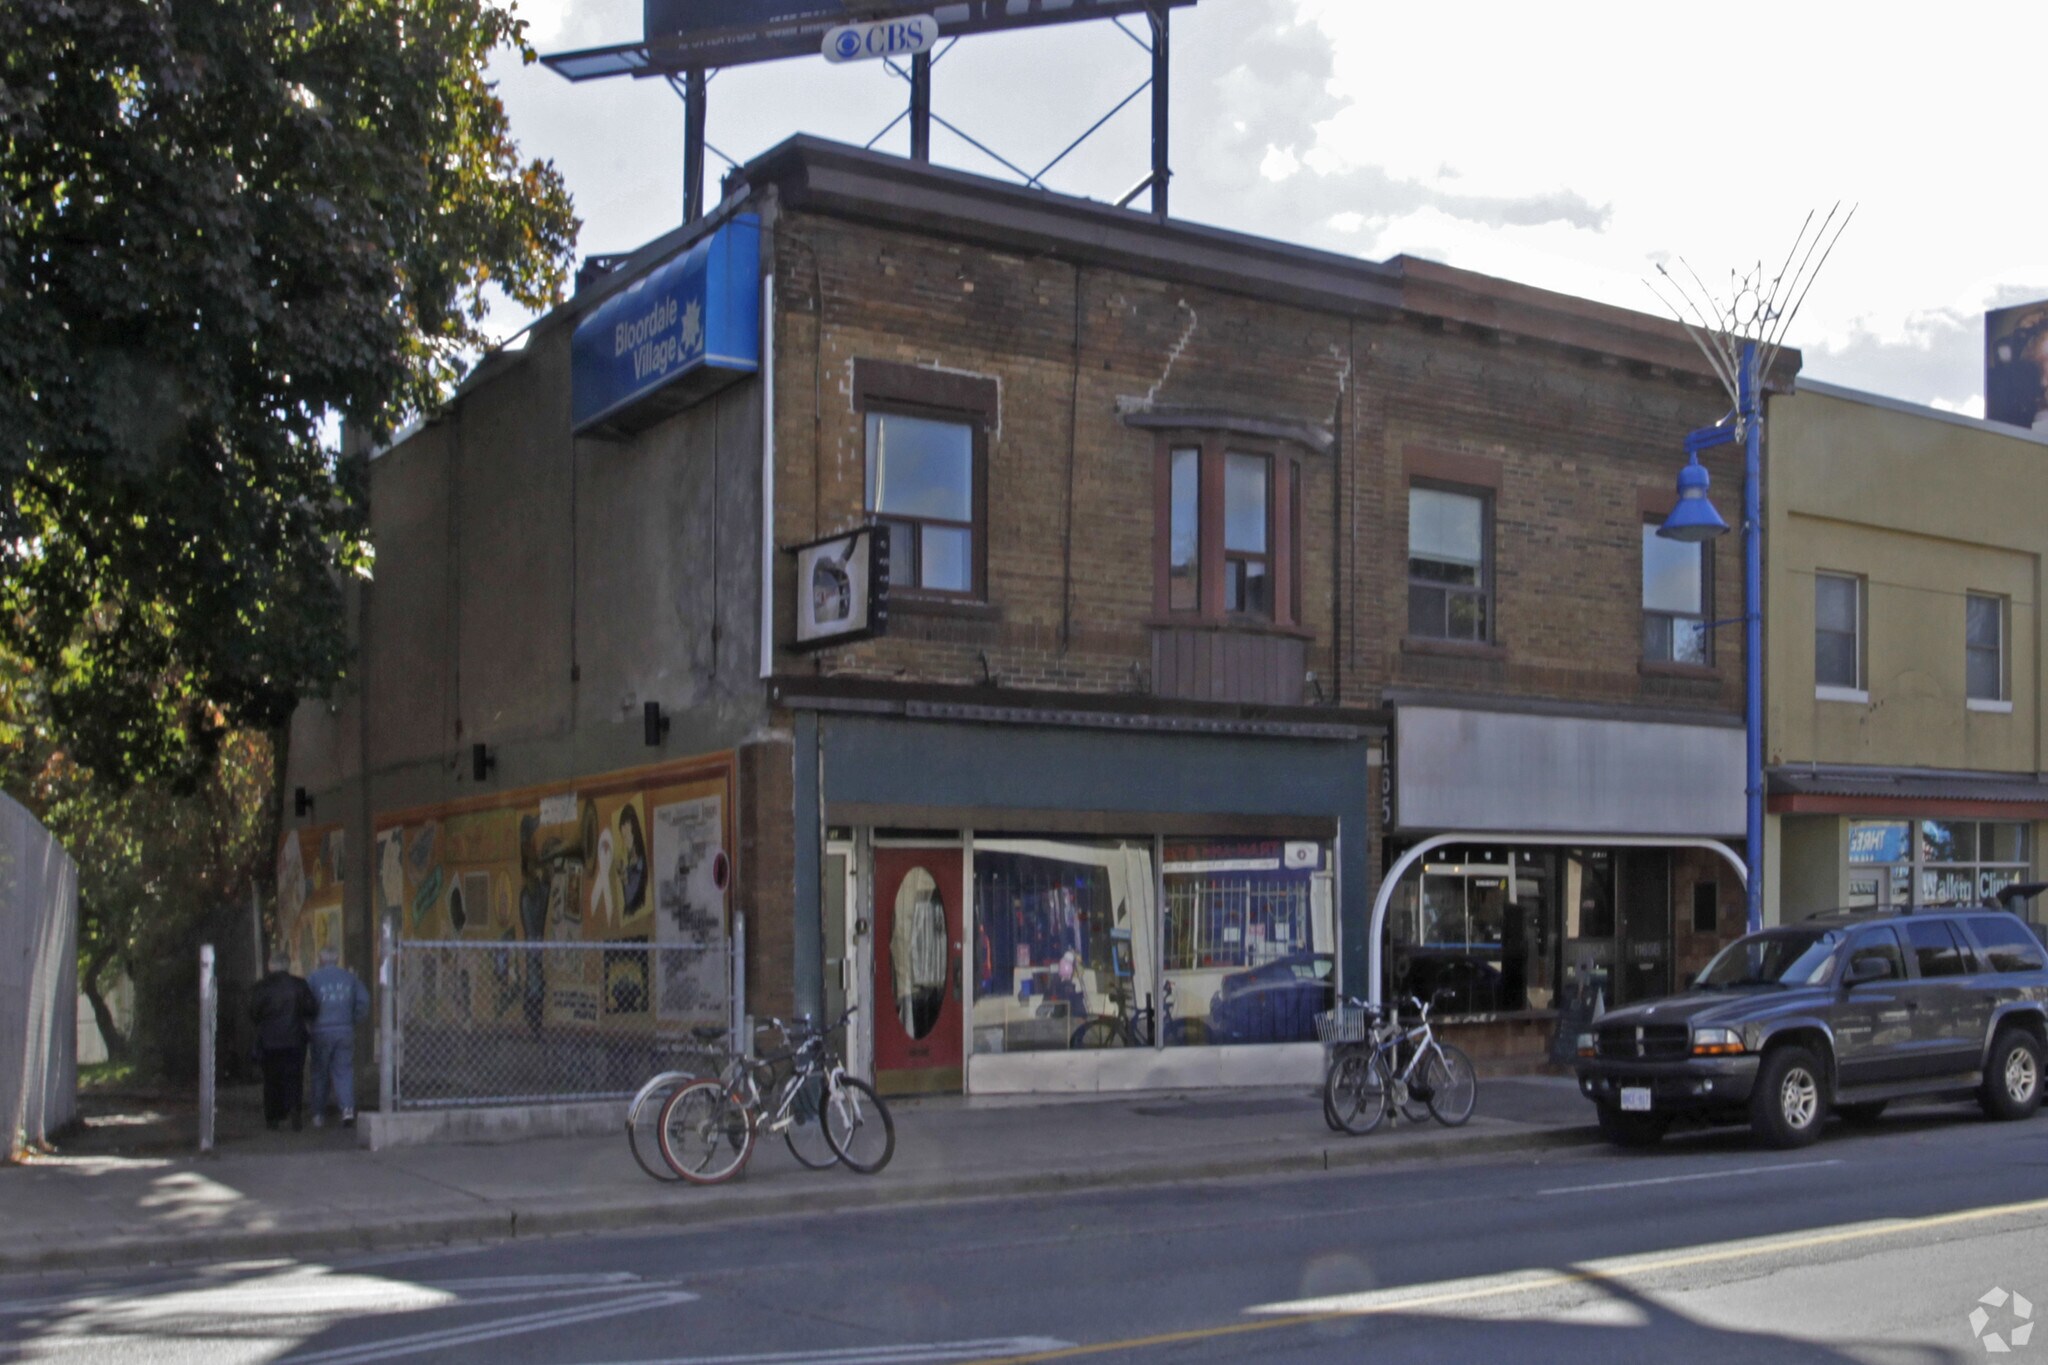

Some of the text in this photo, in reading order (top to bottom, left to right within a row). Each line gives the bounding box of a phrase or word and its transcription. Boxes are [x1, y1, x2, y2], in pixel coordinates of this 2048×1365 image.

[866, 19, 923, 53] CBS
[615, 296, 677, 356] Bloordale
[633, 336, 677, 380] Village
[1980, 871, 2017, 898] Clini
